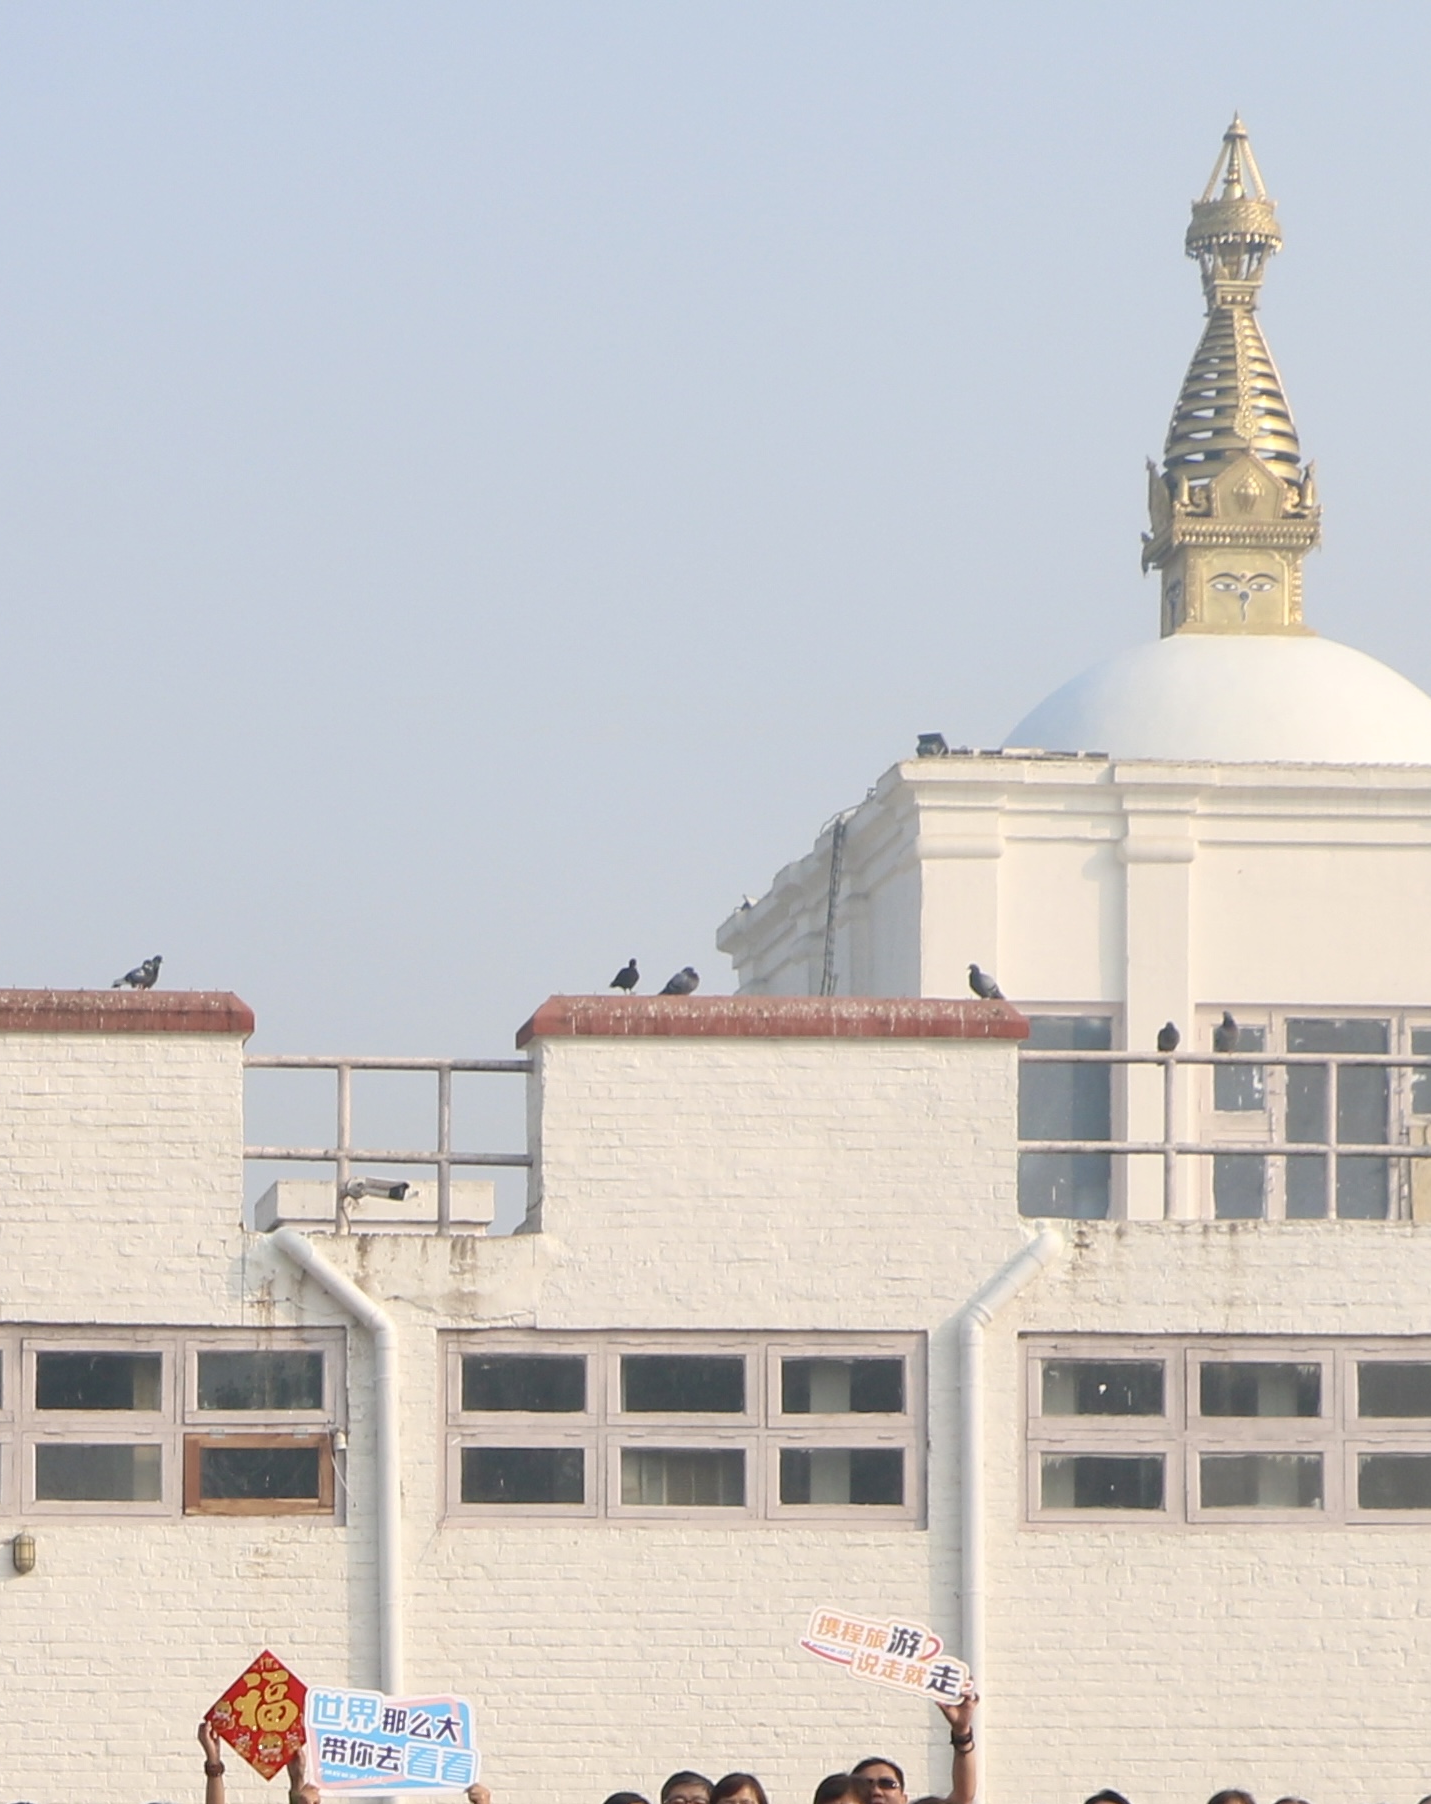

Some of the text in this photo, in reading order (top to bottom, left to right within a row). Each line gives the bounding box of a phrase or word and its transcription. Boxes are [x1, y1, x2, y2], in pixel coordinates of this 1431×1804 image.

[817, 1615, 923, 1658] 携程旅游
[856, 1652, 961, 1697] 说走就走
[233, 1669, 299, 1733] 福
[312, 1693, 462, 1743] 世界那么大
[321, 1735, 475, 1785] 带你去看看
